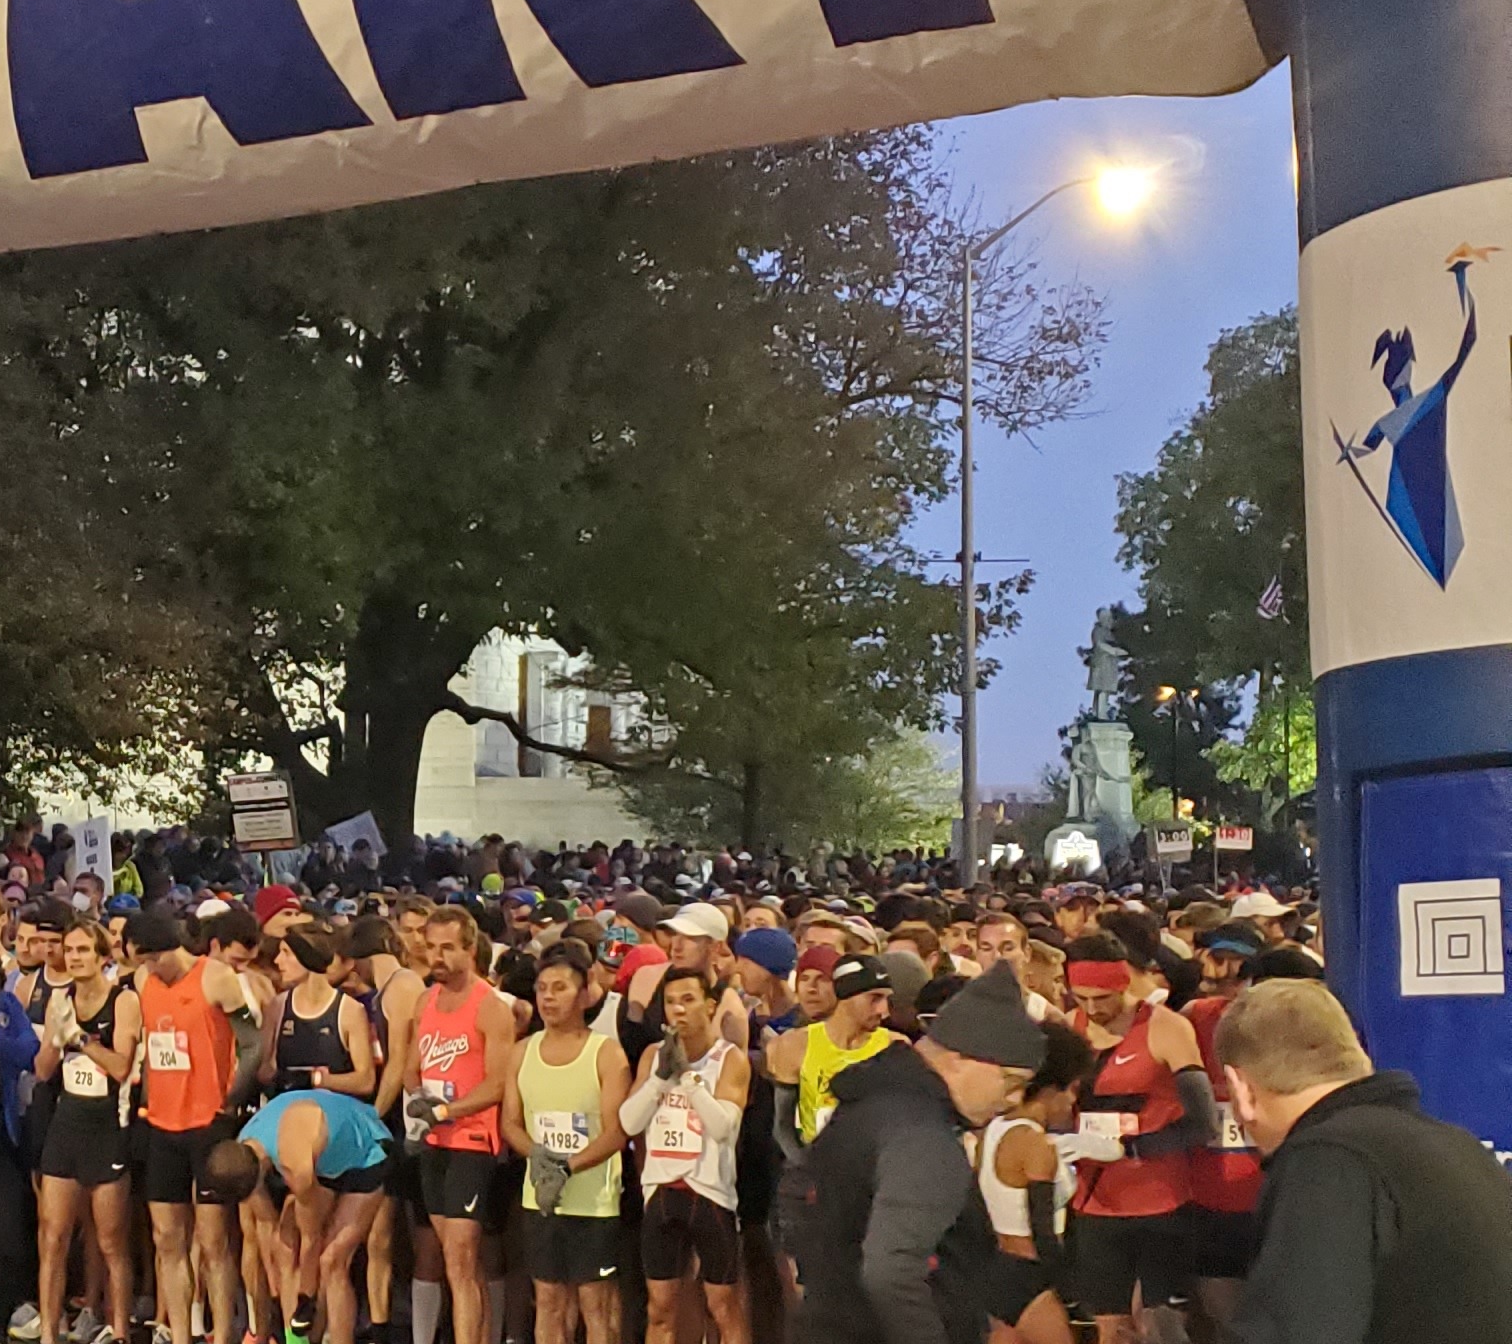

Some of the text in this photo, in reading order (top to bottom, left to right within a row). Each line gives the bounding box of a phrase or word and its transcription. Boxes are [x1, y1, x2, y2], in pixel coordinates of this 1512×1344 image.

[159, 1051, 177, 1067] 204
[419, 1030, 469, 1072] Chicago
[75, 1071, 93, 1086] 278
[543, 1130, 580, 1149] A1982
[664, 1130, 684, 1147] 251
